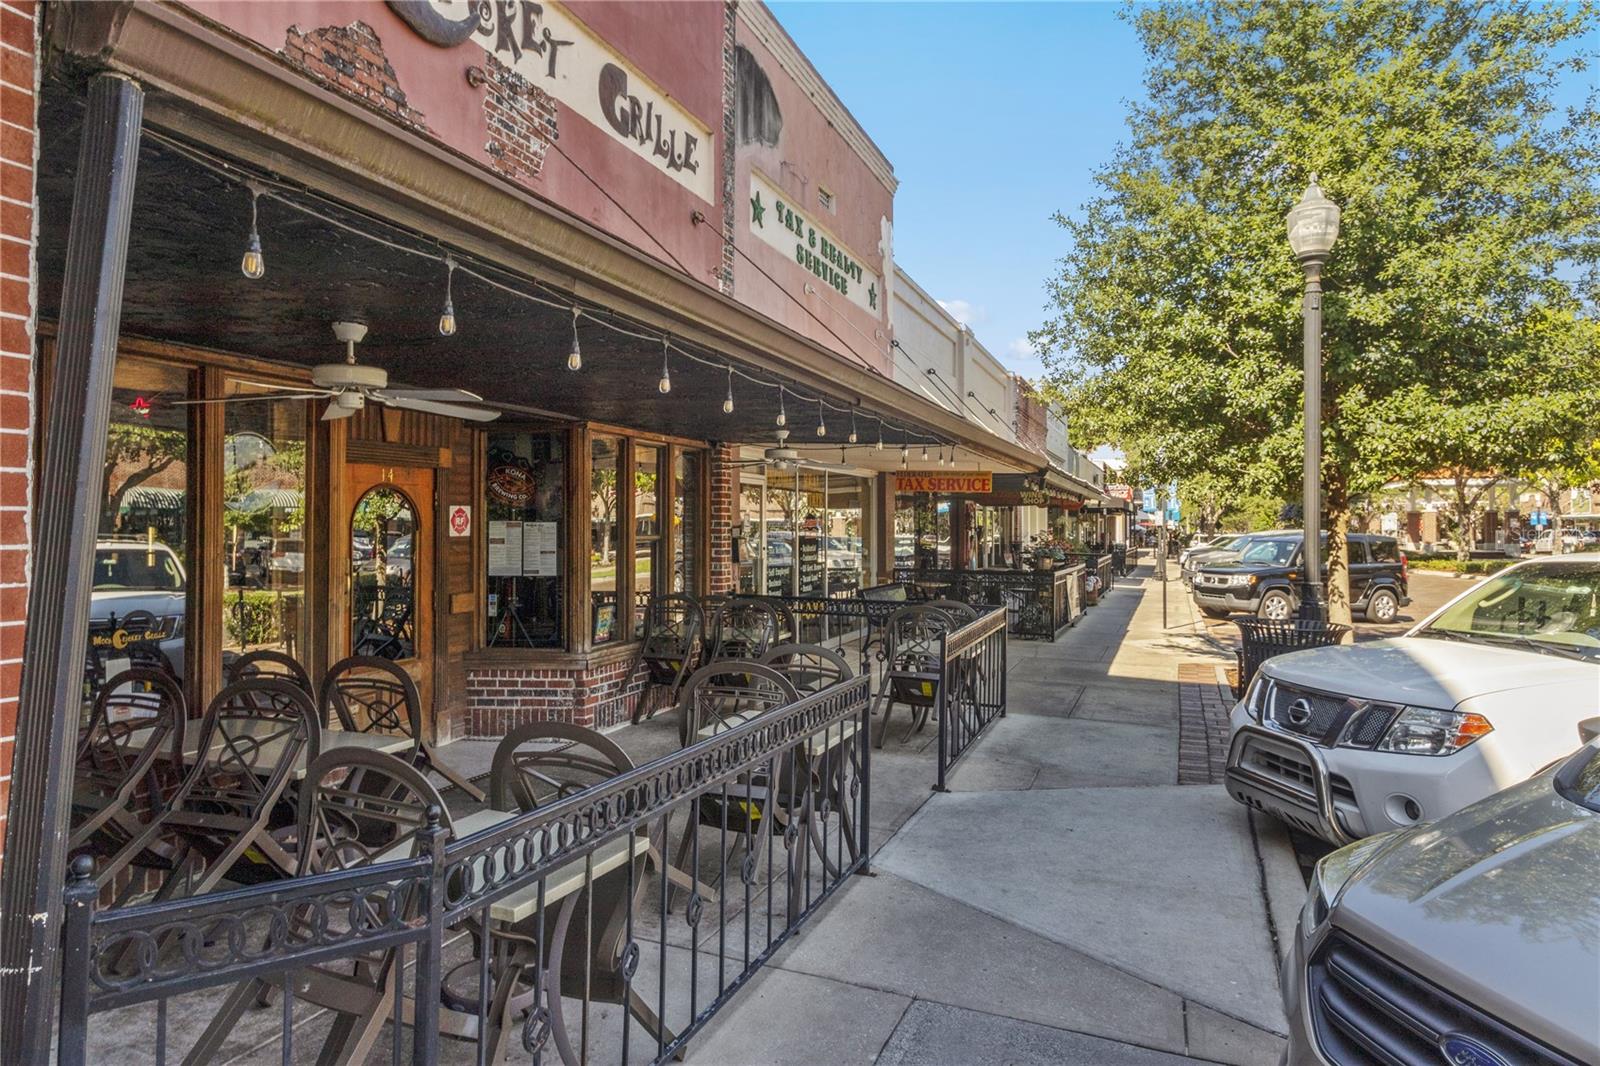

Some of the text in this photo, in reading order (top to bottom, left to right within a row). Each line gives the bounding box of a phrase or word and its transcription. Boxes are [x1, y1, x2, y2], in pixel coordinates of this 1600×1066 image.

[598, 62, 700, 176] GRILLE
[775, 200, 863, 285] TAX & REALTY
[796, 243, 848, 296] SERVICE
[382, 467, 393, 483] 14
[505, 468, 526, 481] KONA
[491, 482, 518, 500] BREWING
[896, 478, 990, 492] TAX SERVICE
